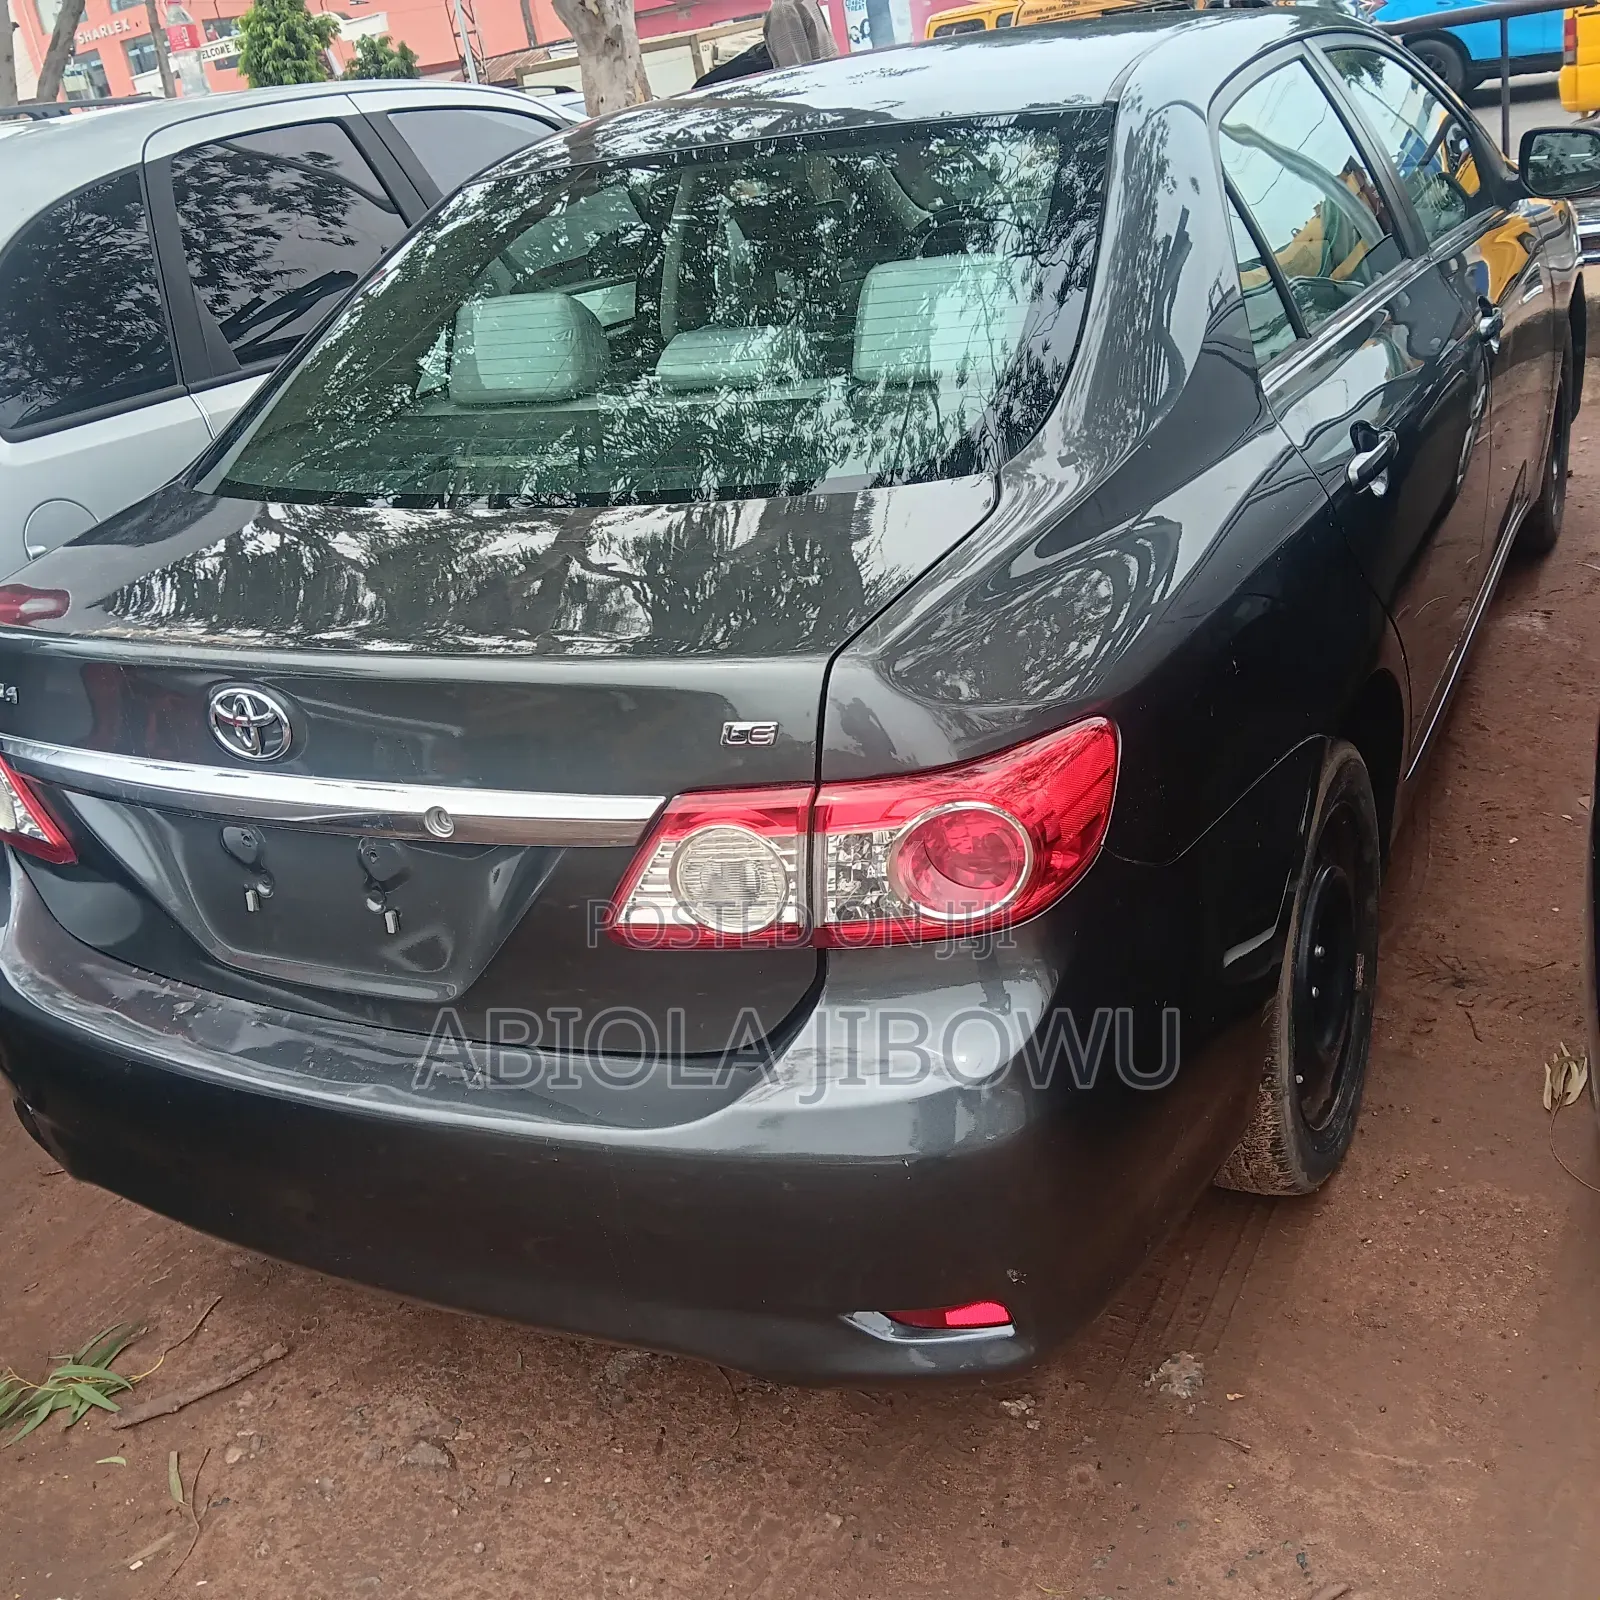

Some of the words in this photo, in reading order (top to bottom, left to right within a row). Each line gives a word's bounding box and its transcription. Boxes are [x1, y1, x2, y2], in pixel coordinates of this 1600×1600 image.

[78, 18, 131, 45] SHARLEX
[201, 43, 231, 60] ELCOME
[720, 722, 778, 746] LE
